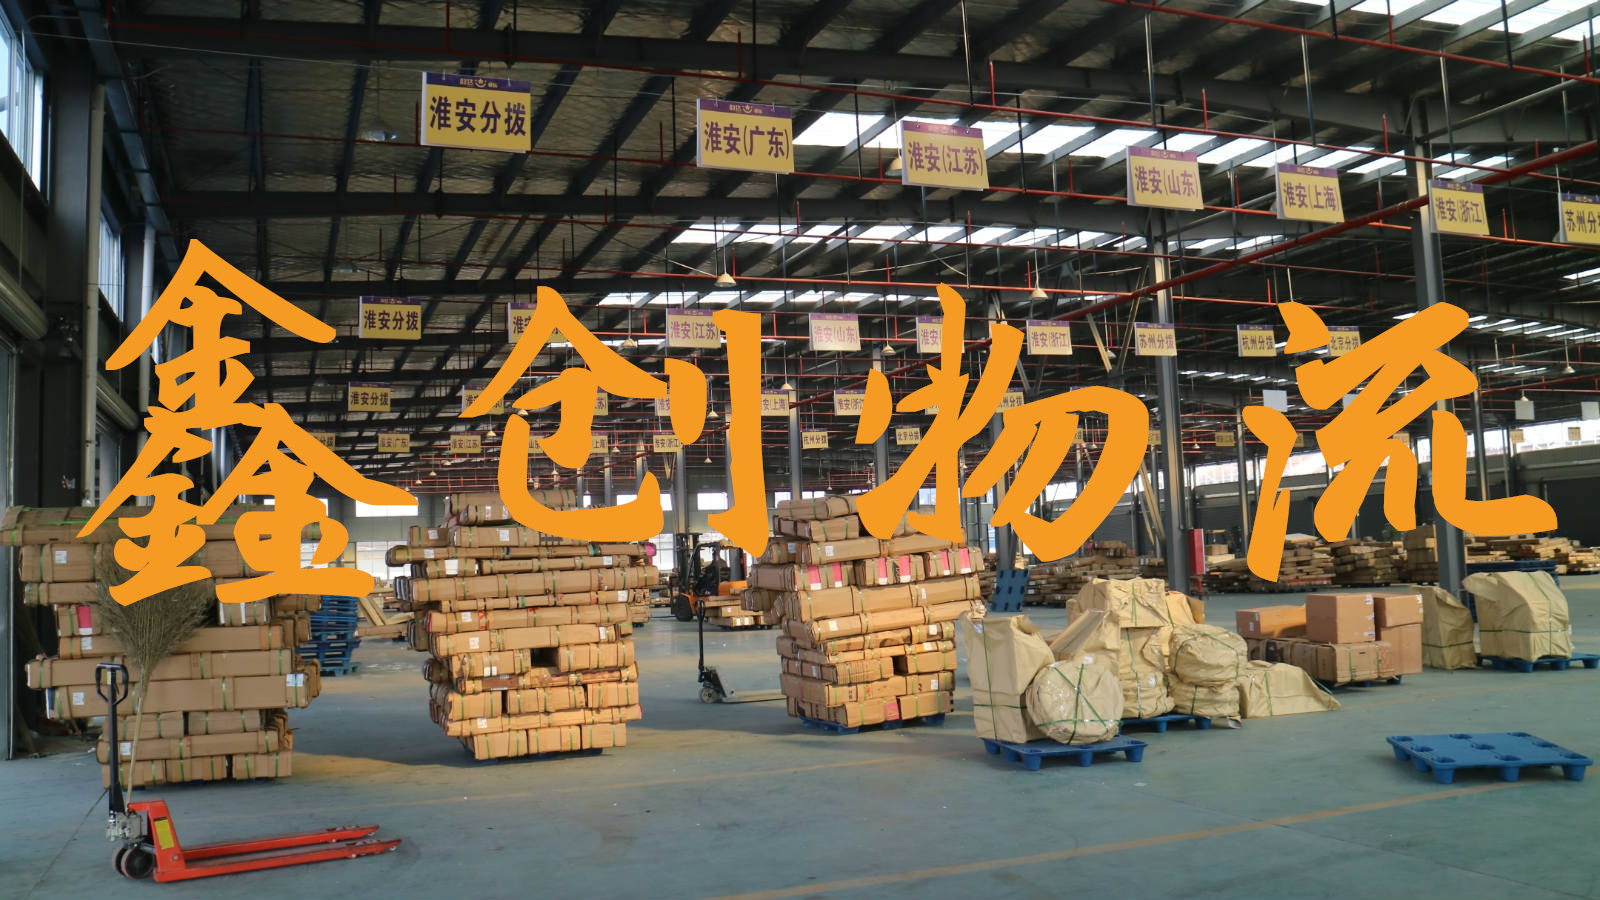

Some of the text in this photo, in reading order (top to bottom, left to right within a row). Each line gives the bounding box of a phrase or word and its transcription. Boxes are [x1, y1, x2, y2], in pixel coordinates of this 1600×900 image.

[429, 95, 526, 136] 淮安分拨
[704, 121, 790, 160] 淮安(广东)
[908, 141, 983, 176] 淮安(江苏)
[1135, 165, 1198, 198] 淮安(山东)
[1283, 181, 1339, 212] 淮安(上海)
[1435, 196, 1485, 224] 淮安(浙江)
[1565, 209, 1600, 234] 苏州分
[363, 309, 419, 331] 淮安分拨
[670, 320, 719, 340] 淮安(江苏)
[1139, 332, 1174, 350] 苏州分拨
[351, 391, 389, 406] 淮安分拨
